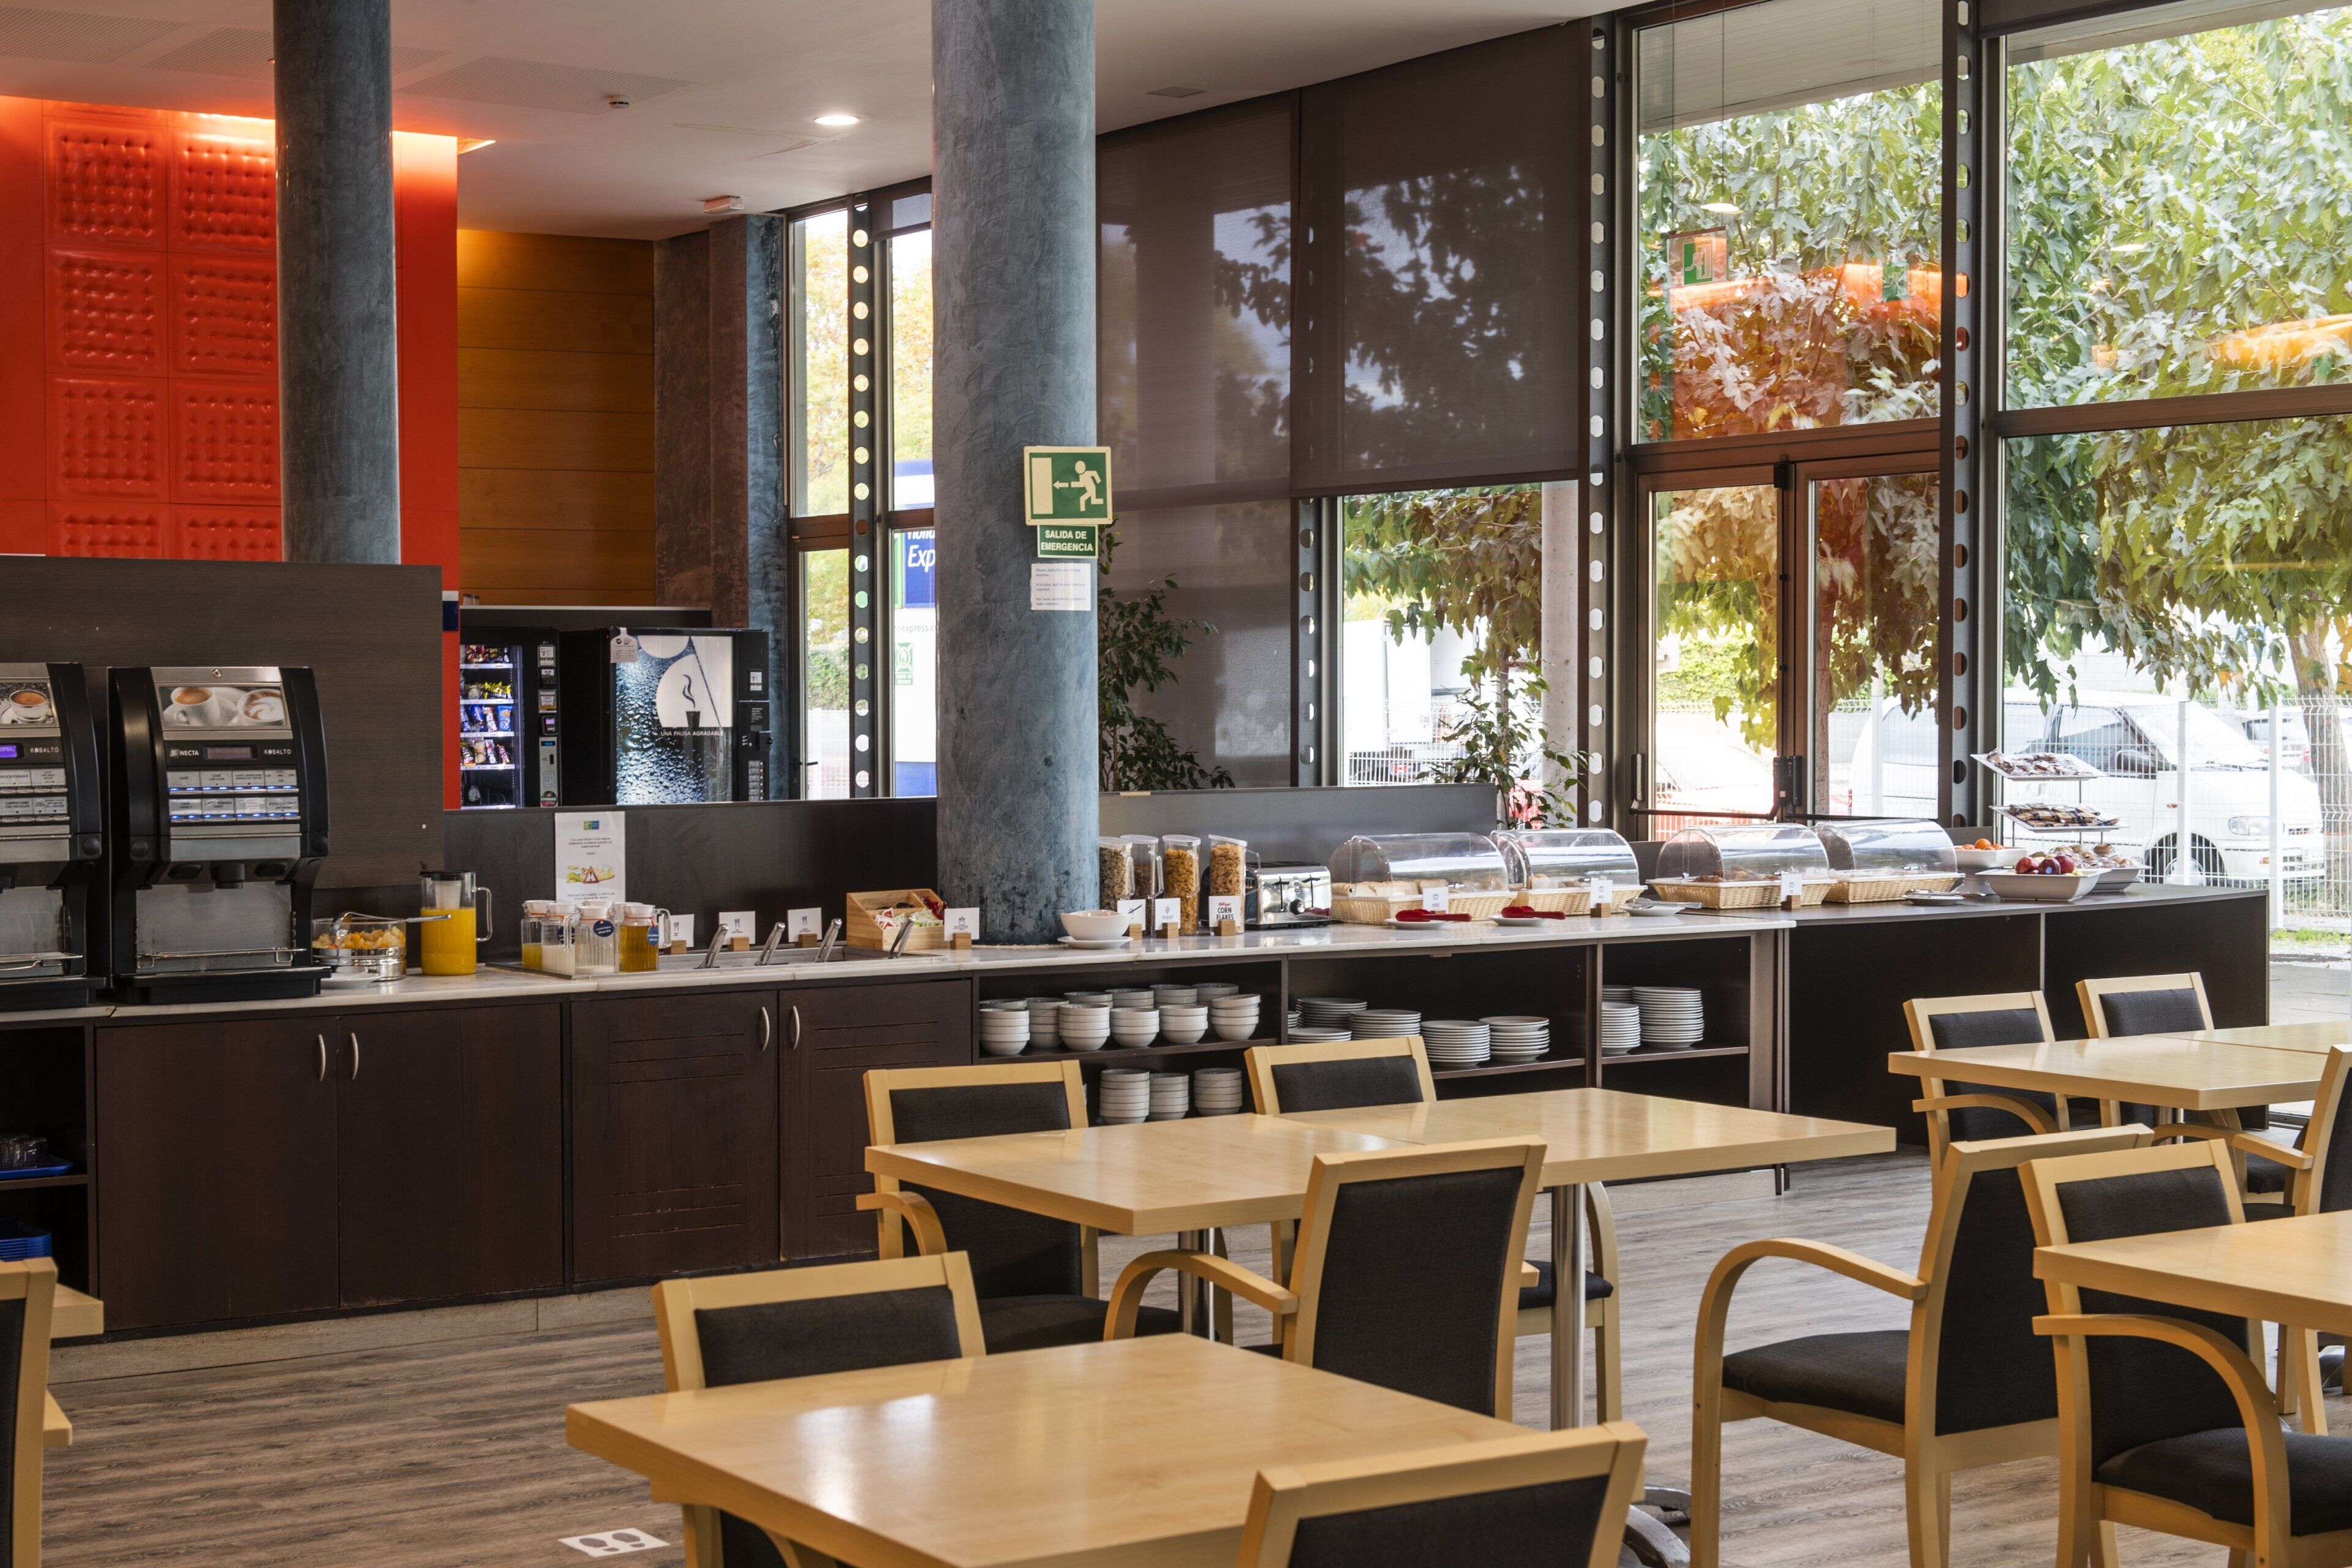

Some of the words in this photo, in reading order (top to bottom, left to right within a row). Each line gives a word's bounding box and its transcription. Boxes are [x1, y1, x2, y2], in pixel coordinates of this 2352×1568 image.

[1045, 530, 1074, 539] SALIDA
[1075, 530, 1087, 540] DE
[1041, 541, 1094, 552] EMERGENCIA
[908, 545, 935, 573] Exp
